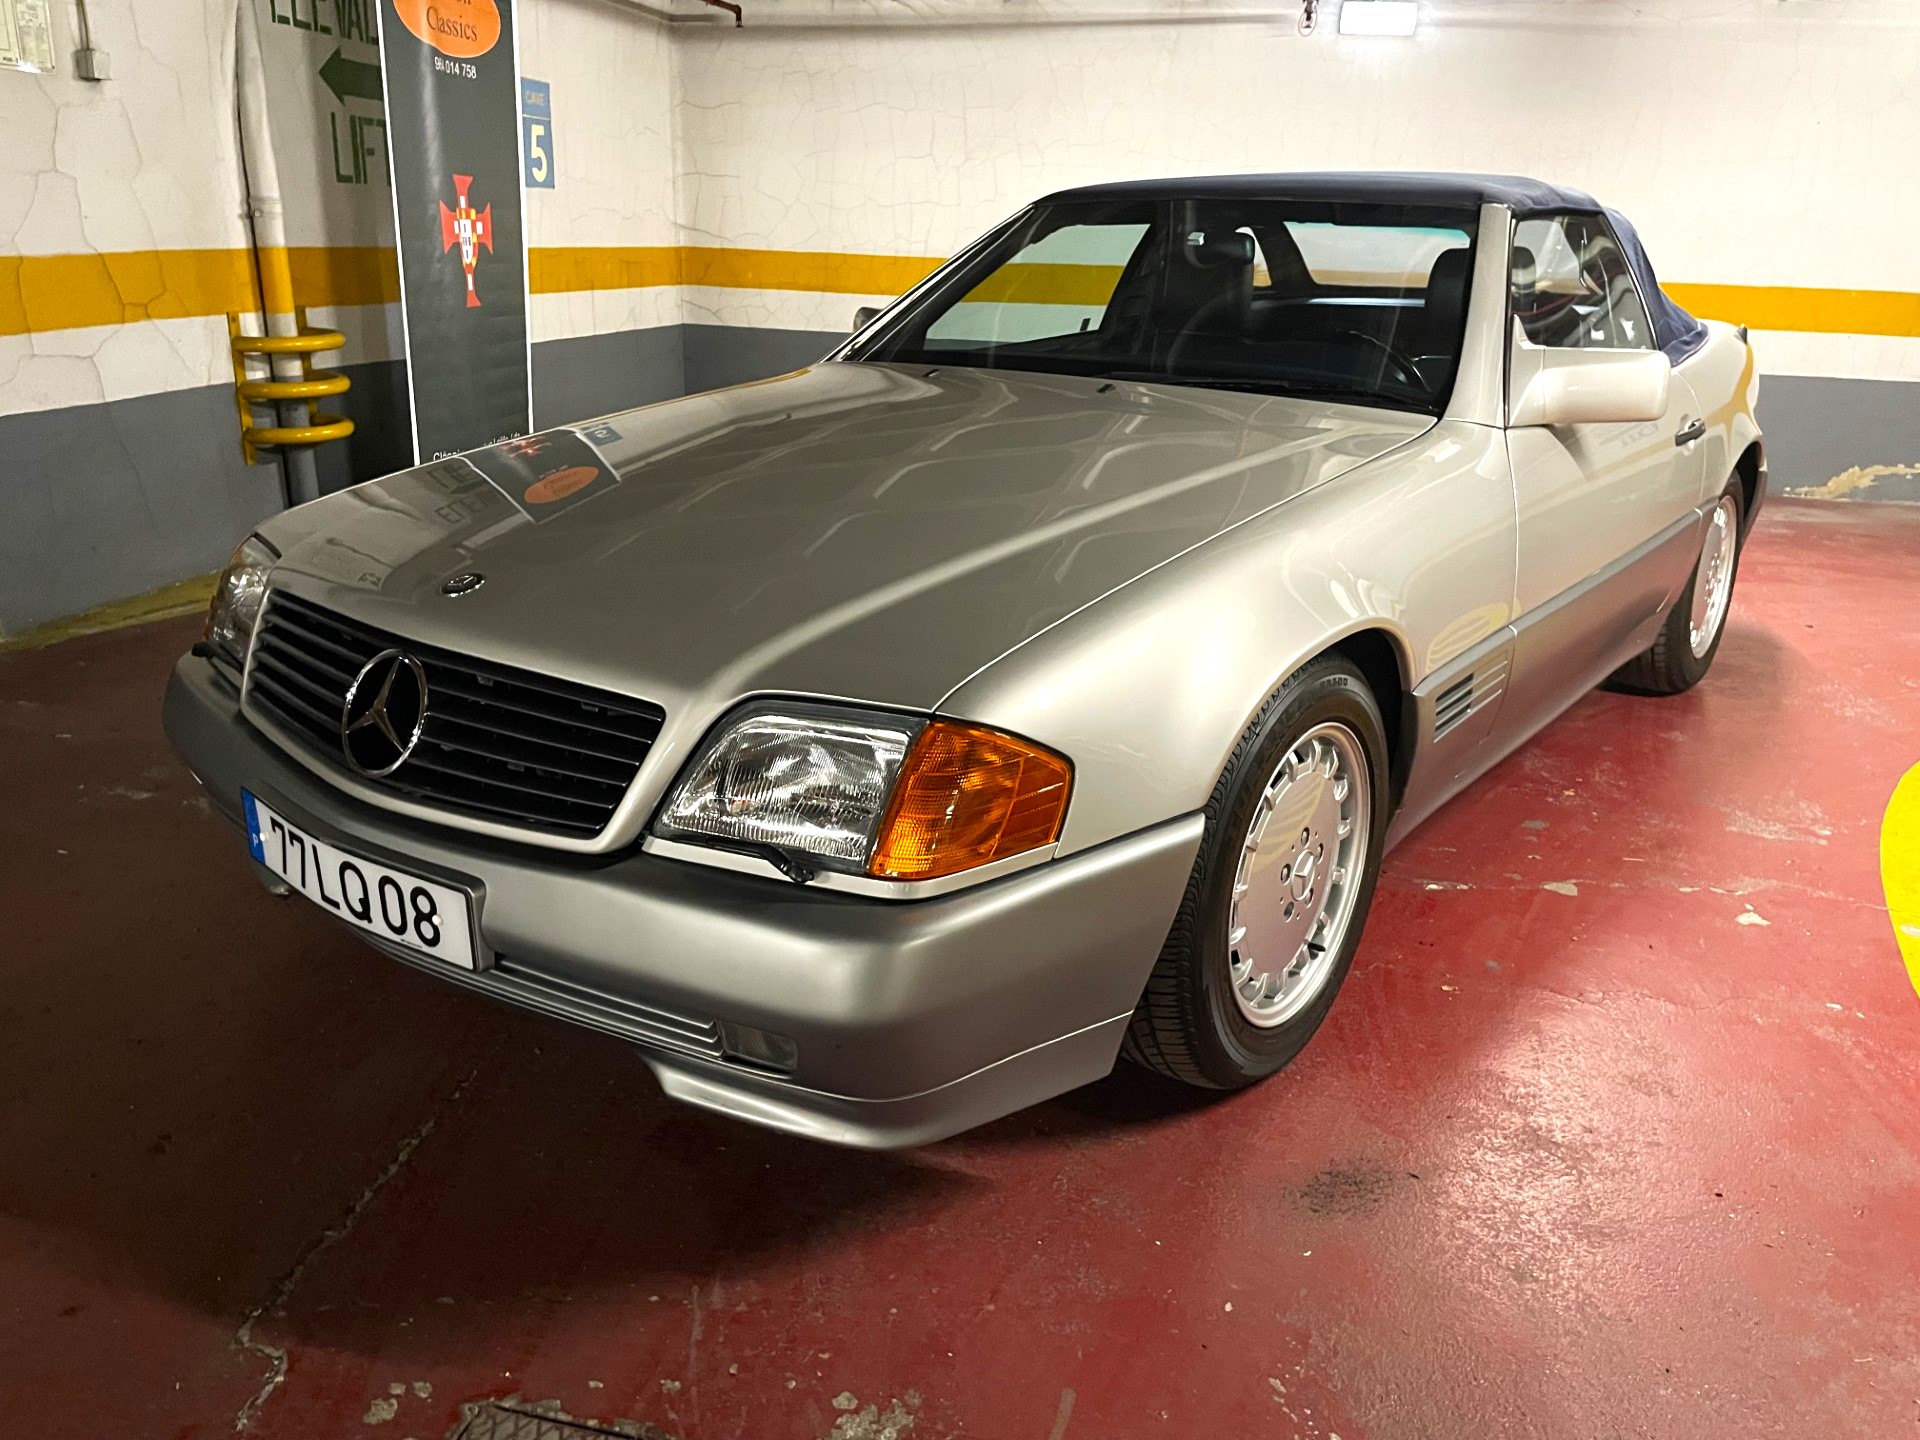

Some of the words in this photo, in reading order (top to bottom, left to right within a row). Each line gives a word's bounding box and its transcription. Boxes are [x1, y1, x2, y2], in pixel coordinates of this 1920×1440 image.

[426, 6, 478, 42] Classics
[445, 60, 460, 76] 014
[461, 63, 477, 79] 758
[531, 124, 548, 182] 5
[270, 816, 441, 948] 77LQ08
